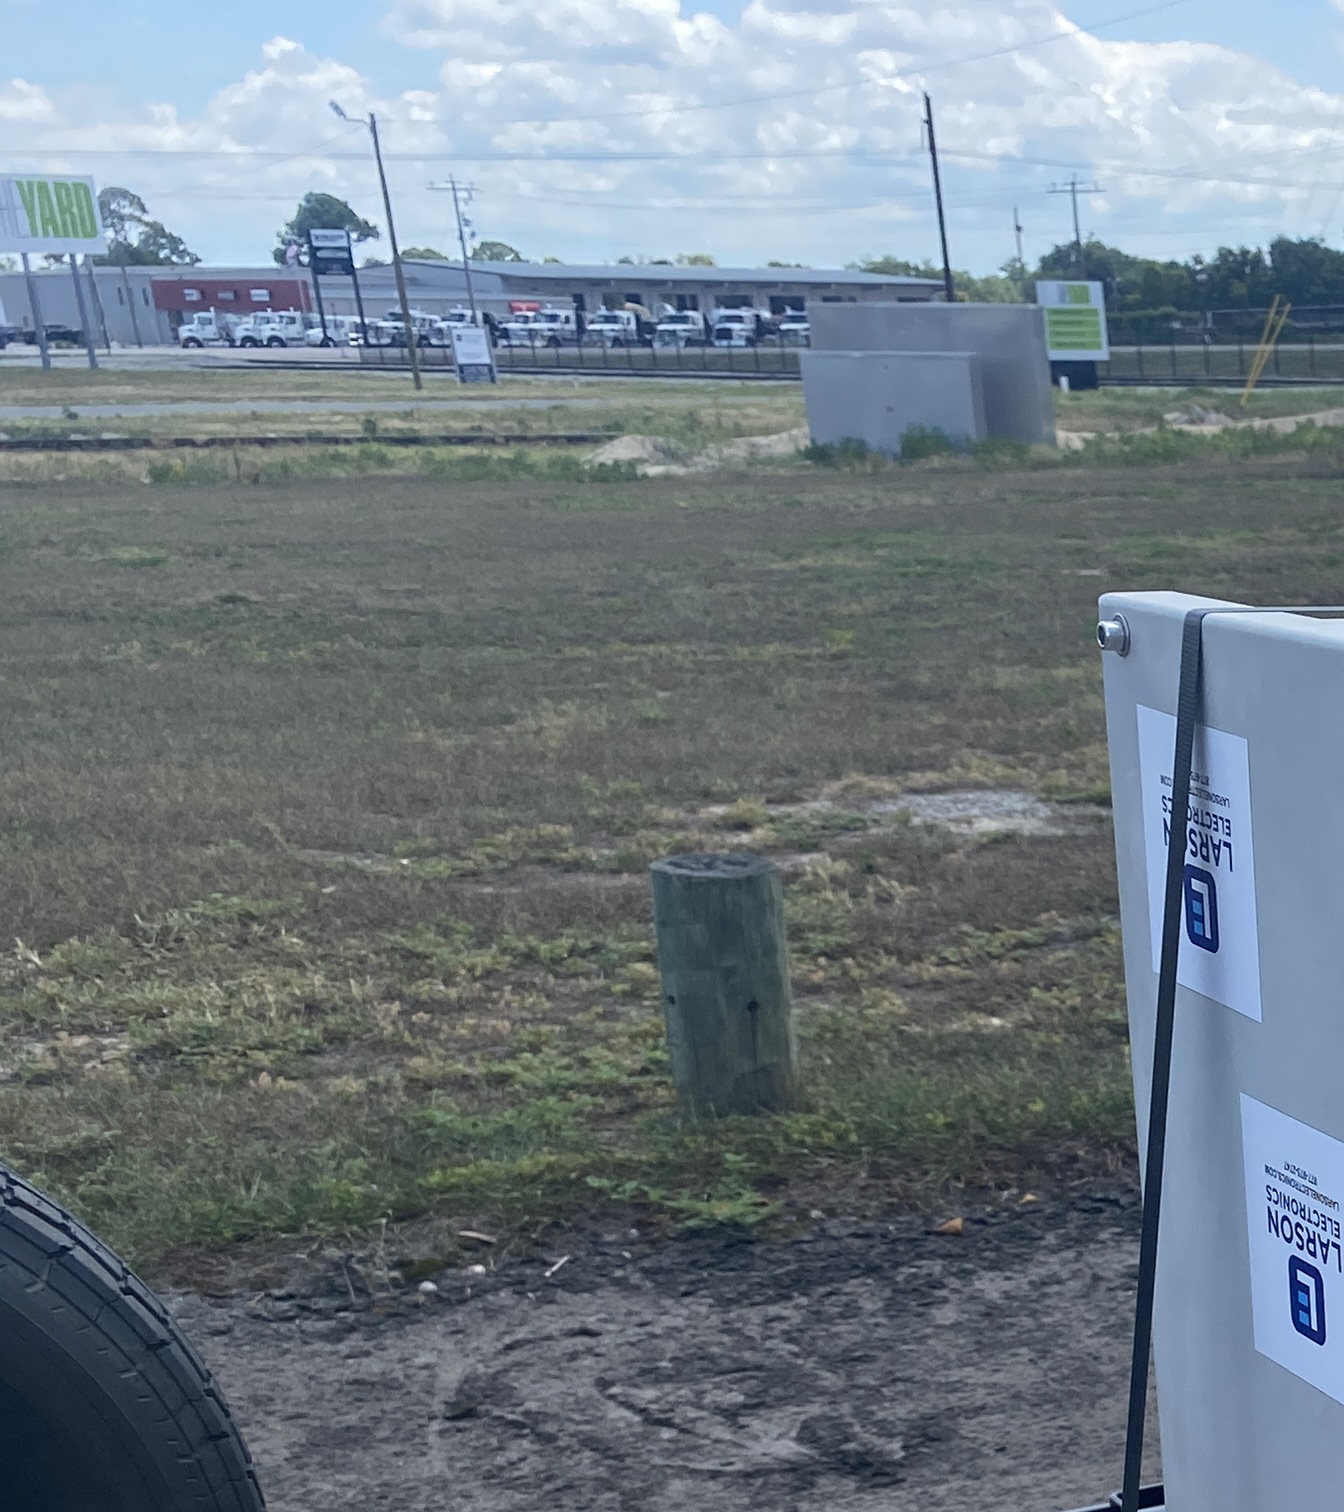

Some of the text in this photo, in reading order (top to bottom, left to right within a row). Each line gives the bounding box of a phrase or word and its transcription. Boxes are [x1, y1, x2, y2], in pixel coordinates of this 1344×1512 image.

[15, 180, 97, 238] YARD
[1161, 795, 1231, 837] ELECTROCS
[1162, 817, 1233, 872] LARSN
[1266, 1184, 1341, 1240] ELECTRONICS
[1267, 1206, 1342, 1273] LARSON
